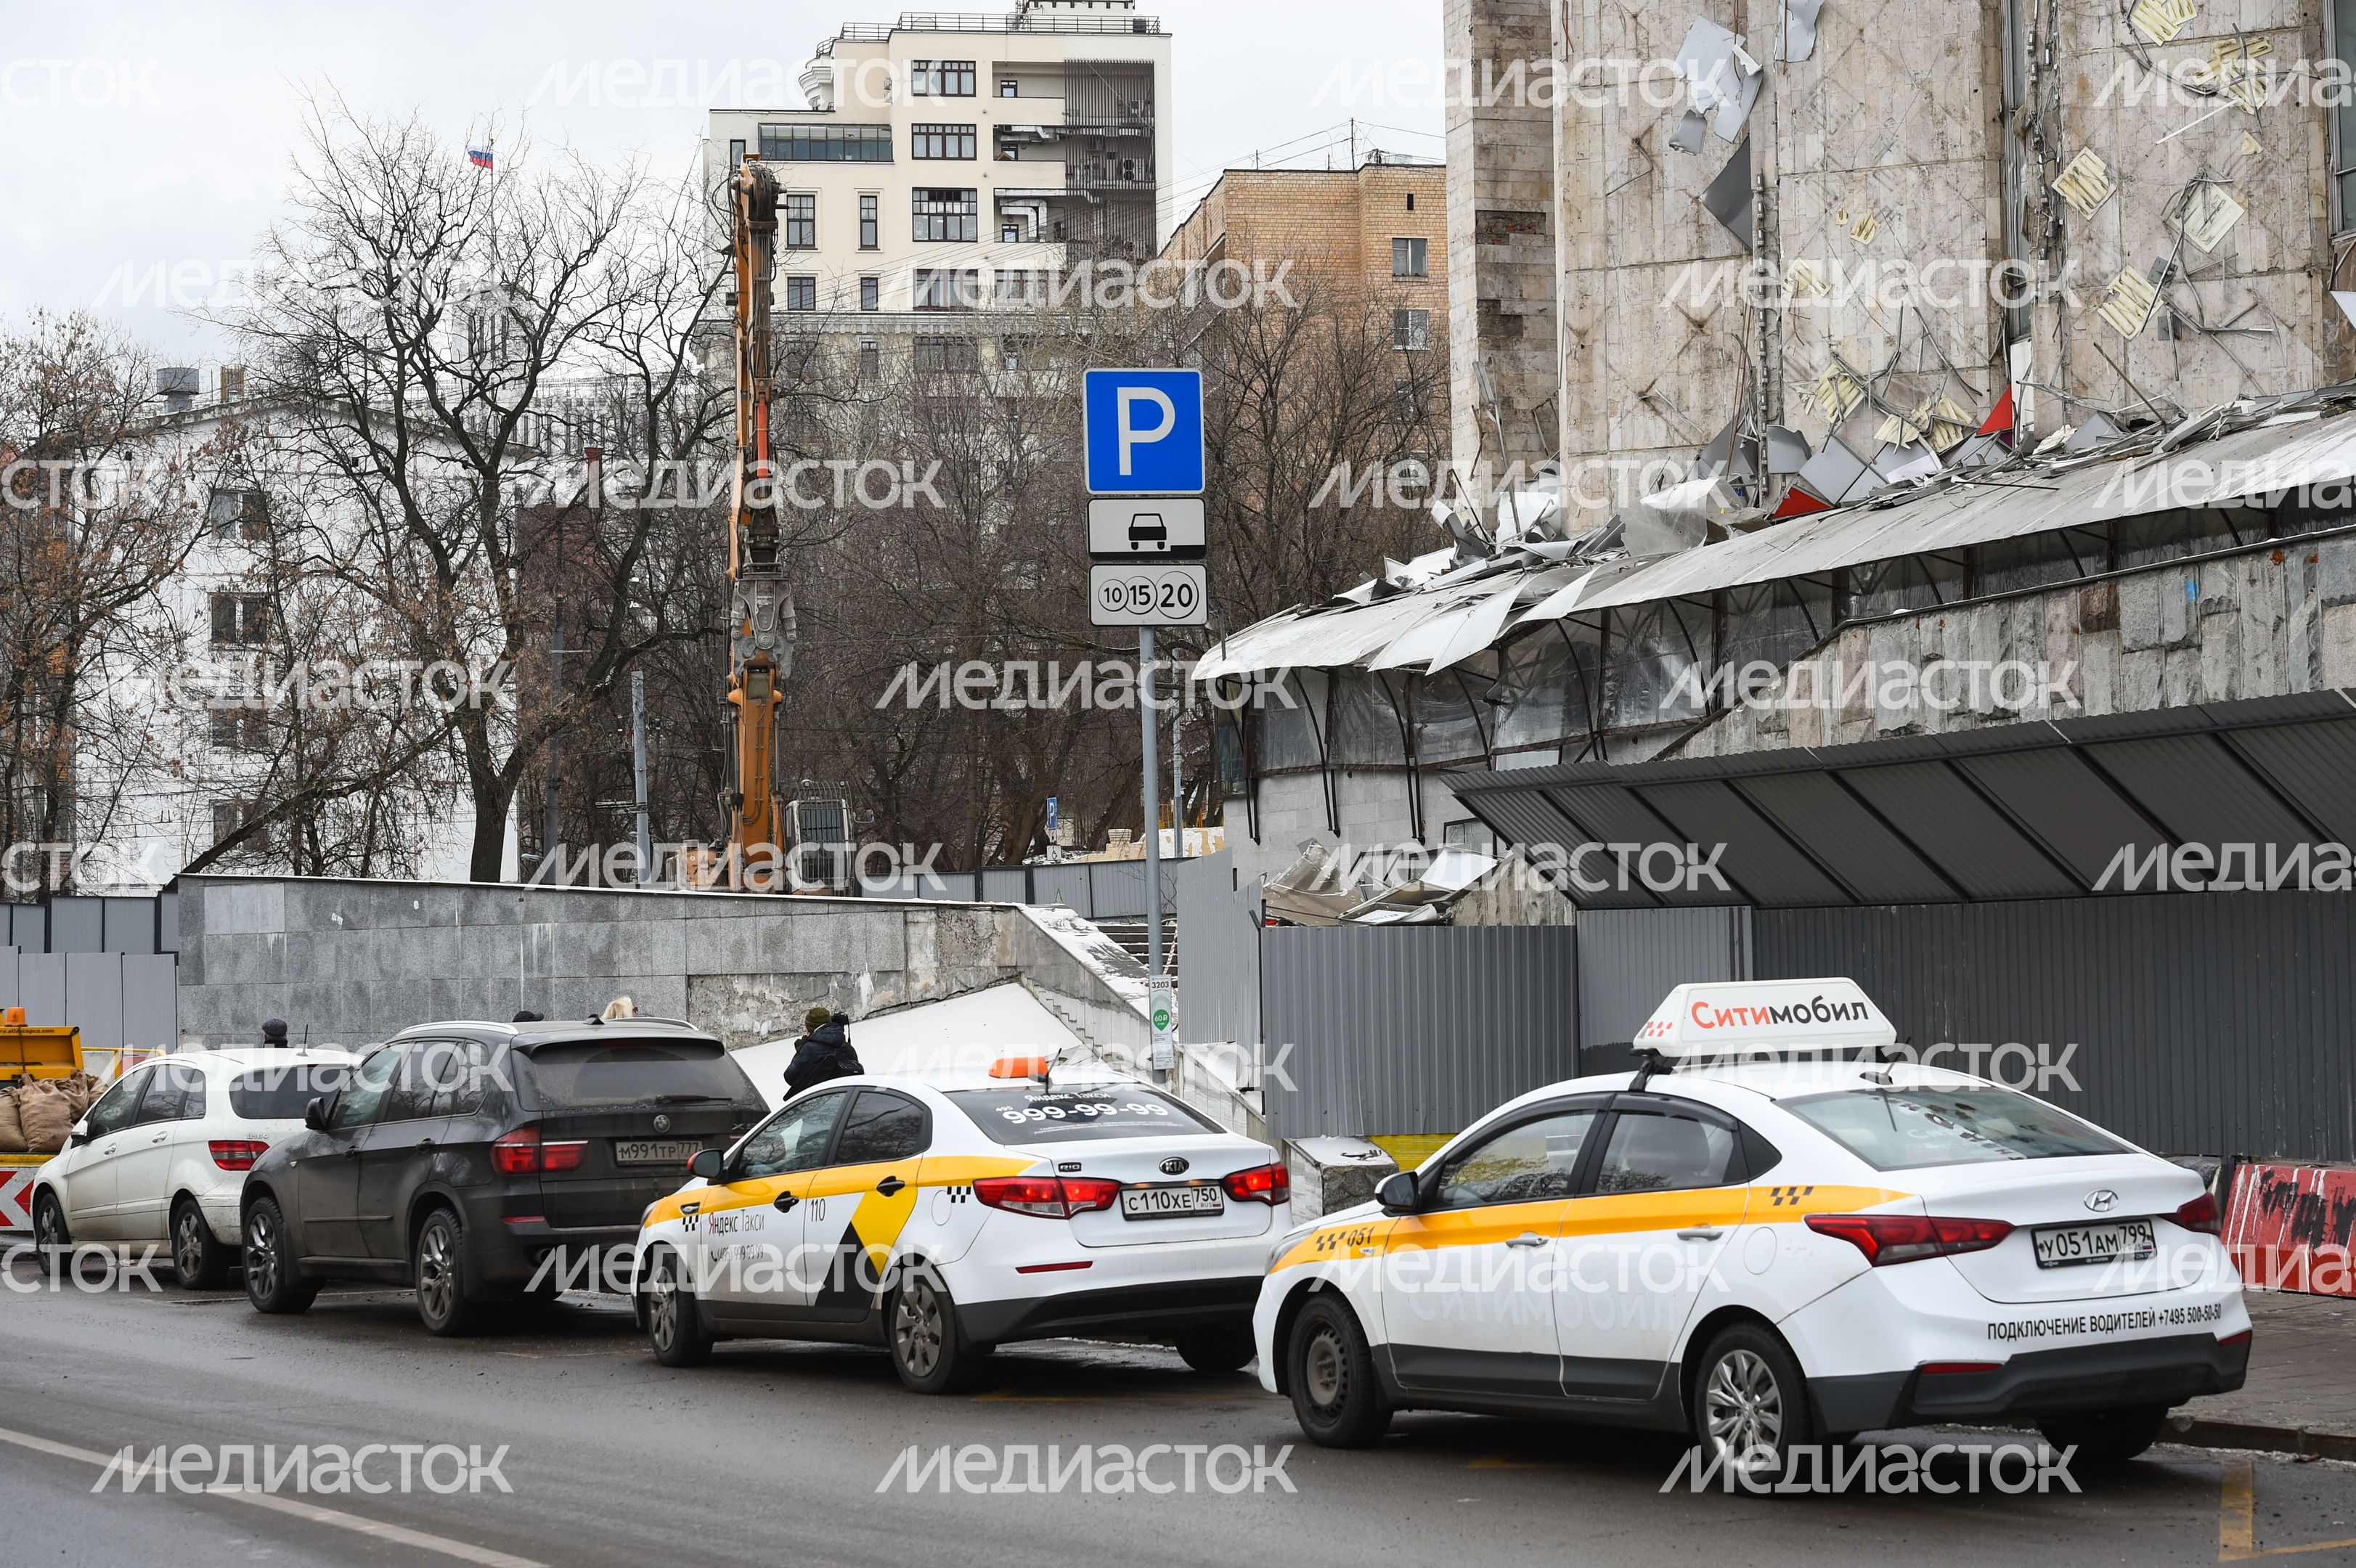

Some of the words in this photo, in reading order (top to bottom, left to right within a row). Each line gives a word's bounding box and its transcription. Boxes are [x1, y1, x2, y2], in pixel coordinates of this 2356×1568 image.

[1117, 386, 1175, 475] P
[1104, 587, 1122, 603] 10
[1129, 584, 1151, 605] 15
[1160, 583, 1193, 608] 20
[1049, 802, 1055, 825] P
[1692, 995, 1869, 1029] Ситимобил
[1024, 1093, 1074, 1103] Яндекс
[1002, 1103, 1169, 1124] 999-99-99
[1165, 1161, 1186, 1172] KIA
[1193, 1188, 1218, 1203] 750
[810, 1199, 826, 1222] 110
[709, 1212, 738, 1236] Яндекс
[741, 1209, 765, 1232] Такси
[1347, 1226, 1374, 1248] 051
[2119, 1225, 2146, 1244] 799
[1987, 1315, 2086, 1342] ПОДКЛЮЧЕНИЕ
[2090, 1307, 2156, 1334] ВОДИТЕЛЕЙ
[2159, 1307, 2185, 1326] +7495
